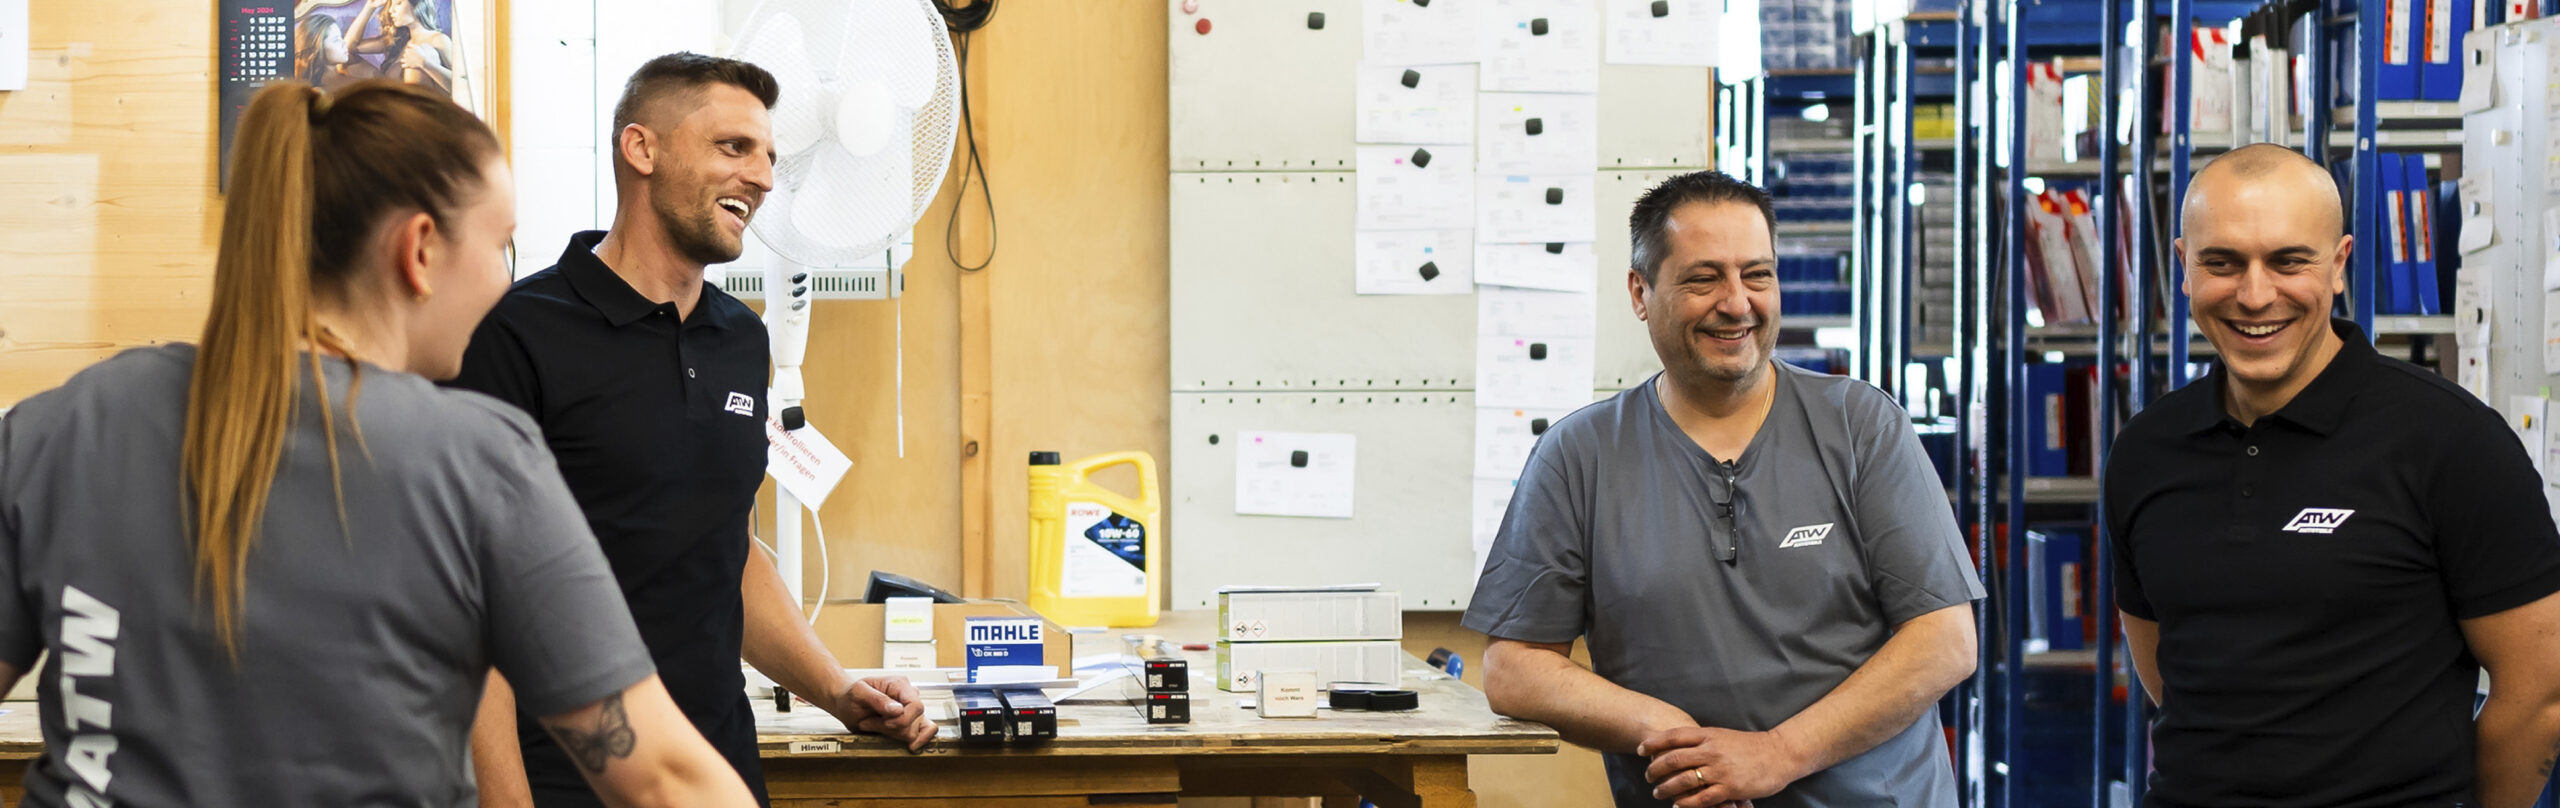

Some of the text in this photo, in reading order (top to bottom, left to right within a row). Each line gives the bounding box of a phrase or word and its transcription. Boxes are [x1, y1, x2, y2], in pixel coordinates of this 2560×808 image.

[2291, 512, 2345, 527] ATW
[1786, 526, 1827, 544] ATW
[971, 625, 1039, 641] MAHLE
[60, 585, 121, 808] ATW
[801, 744, 830, 752] Hinwil
